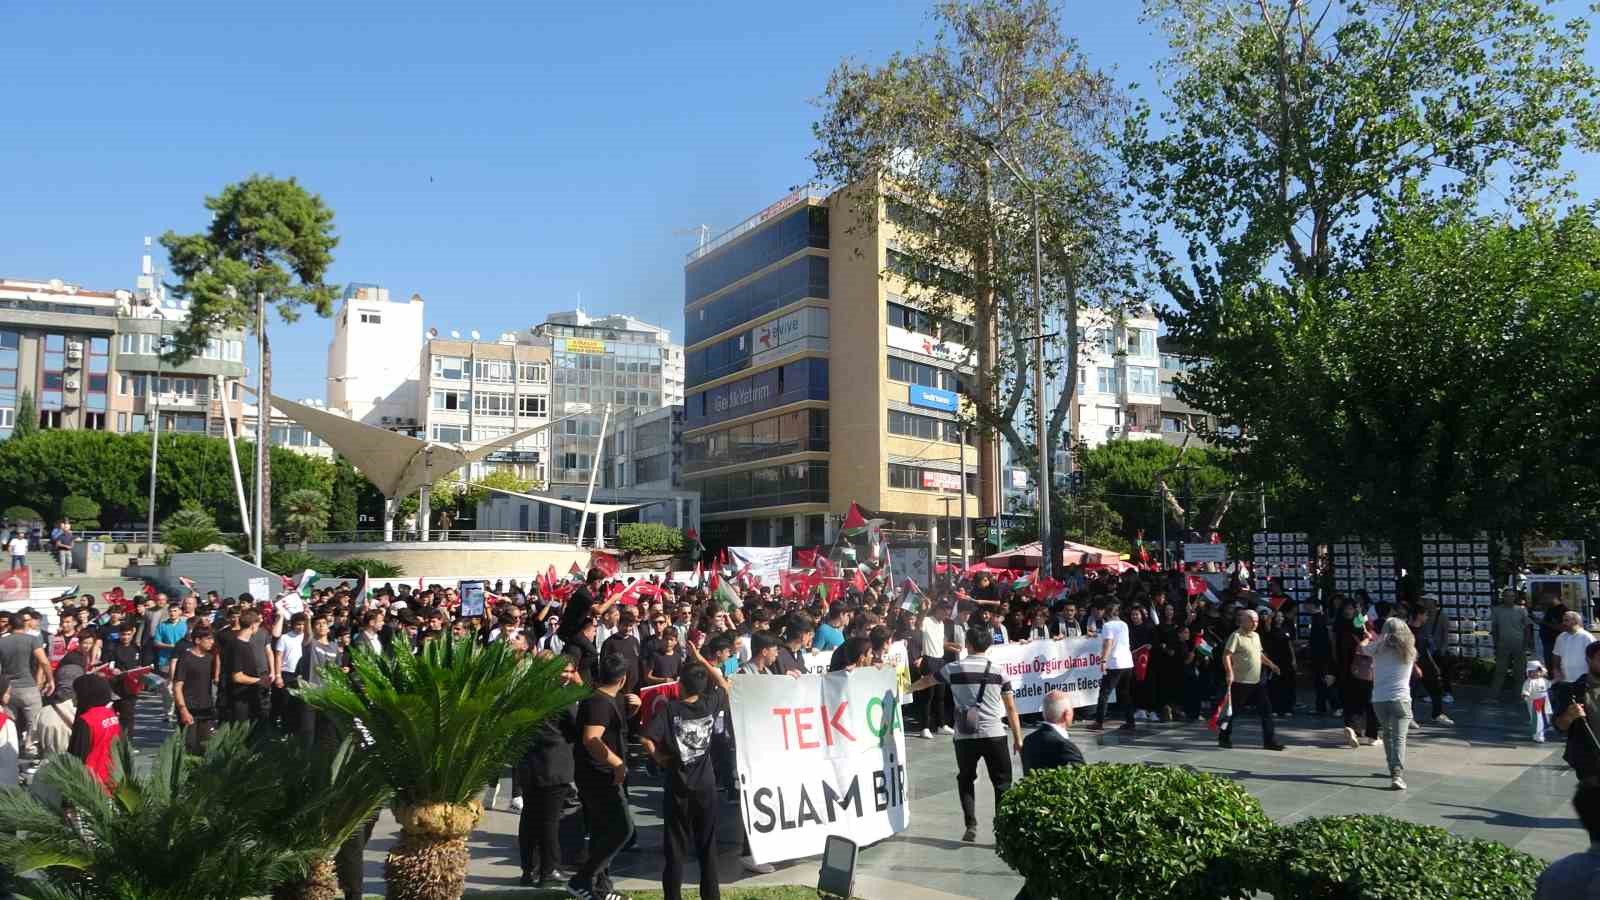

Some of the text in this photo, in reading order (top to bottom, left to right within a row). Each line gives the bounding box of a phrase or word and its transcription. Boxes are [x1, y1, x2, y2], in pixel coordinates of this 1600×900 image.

[1034, 656, 1061, 673] Özgür
[1064, 654, 1088, 669] olana
[1044, 679, 1076, 695] Devam
[772, 700, 857, 750] TEK
[740, 752, 907, 835] İSLAM BİR
